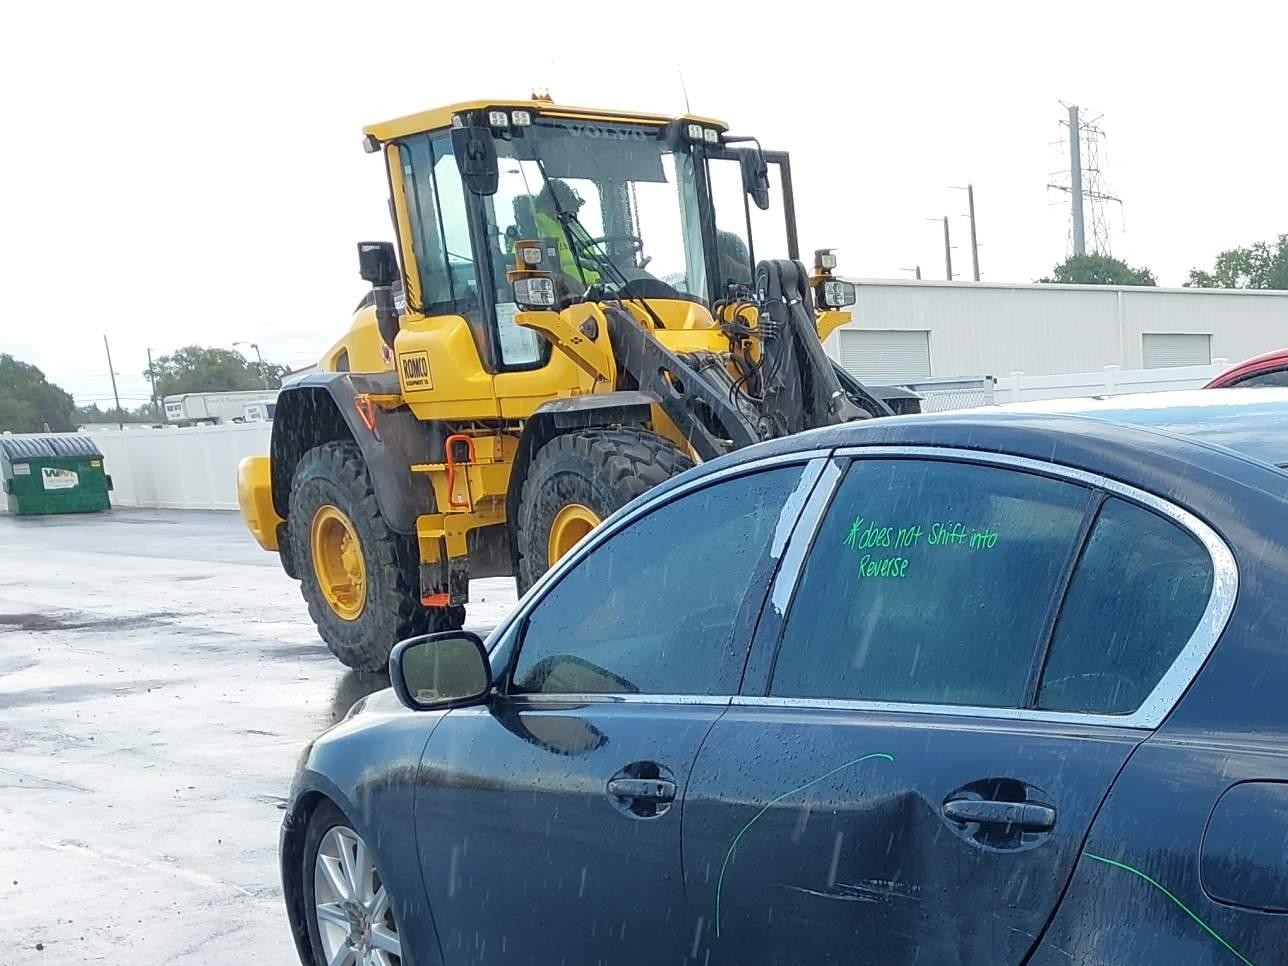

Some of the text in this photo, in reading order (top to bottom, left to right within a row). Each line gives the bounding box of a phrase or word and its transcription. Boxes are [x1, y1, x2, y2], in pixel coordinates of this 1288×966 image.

[403, 356, 428, 379] ROMCO
[858, 521, 893, 549] does
[894, 524, 923, 549] not
[968, 528, 999, 550] into
[858, 554, 909, 578] Reverse
